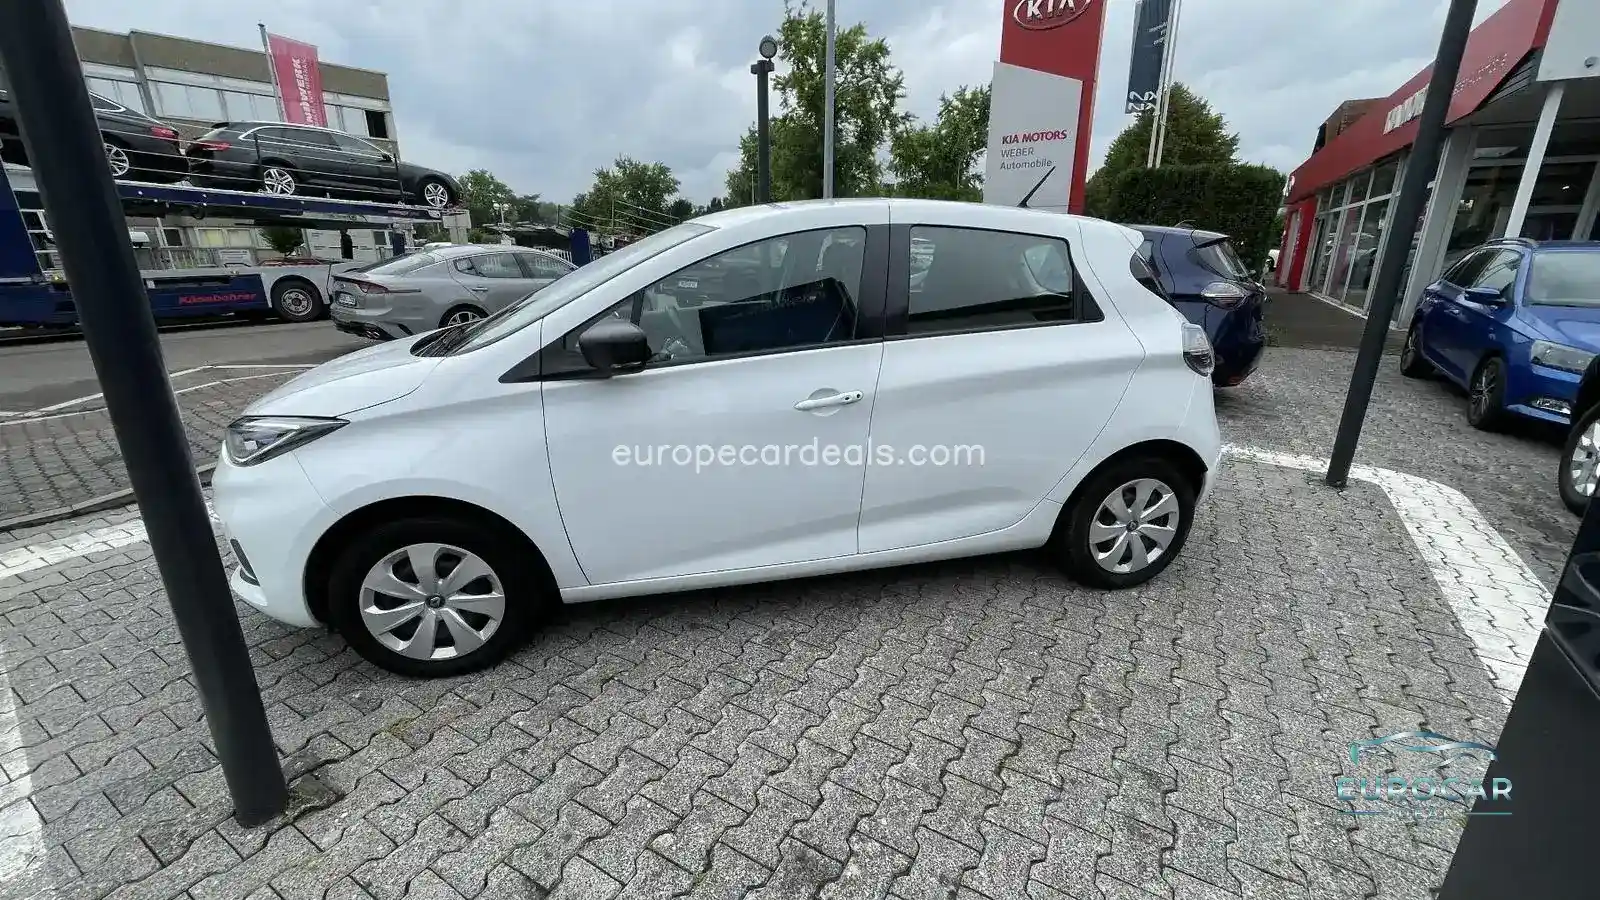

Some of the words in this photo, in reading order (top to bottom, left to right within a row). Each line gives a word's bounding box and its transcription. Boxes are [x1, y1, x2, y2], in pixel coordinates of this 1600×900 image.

[1026, 0, 1077, 20] KIA
[1002, 134, 1020, 145] KIA
[1022, 130, 1068, 143] MOTORS
[1001, 147, 1035, 158] WEBER
[1000, 157, 1053, 170] Automobile
